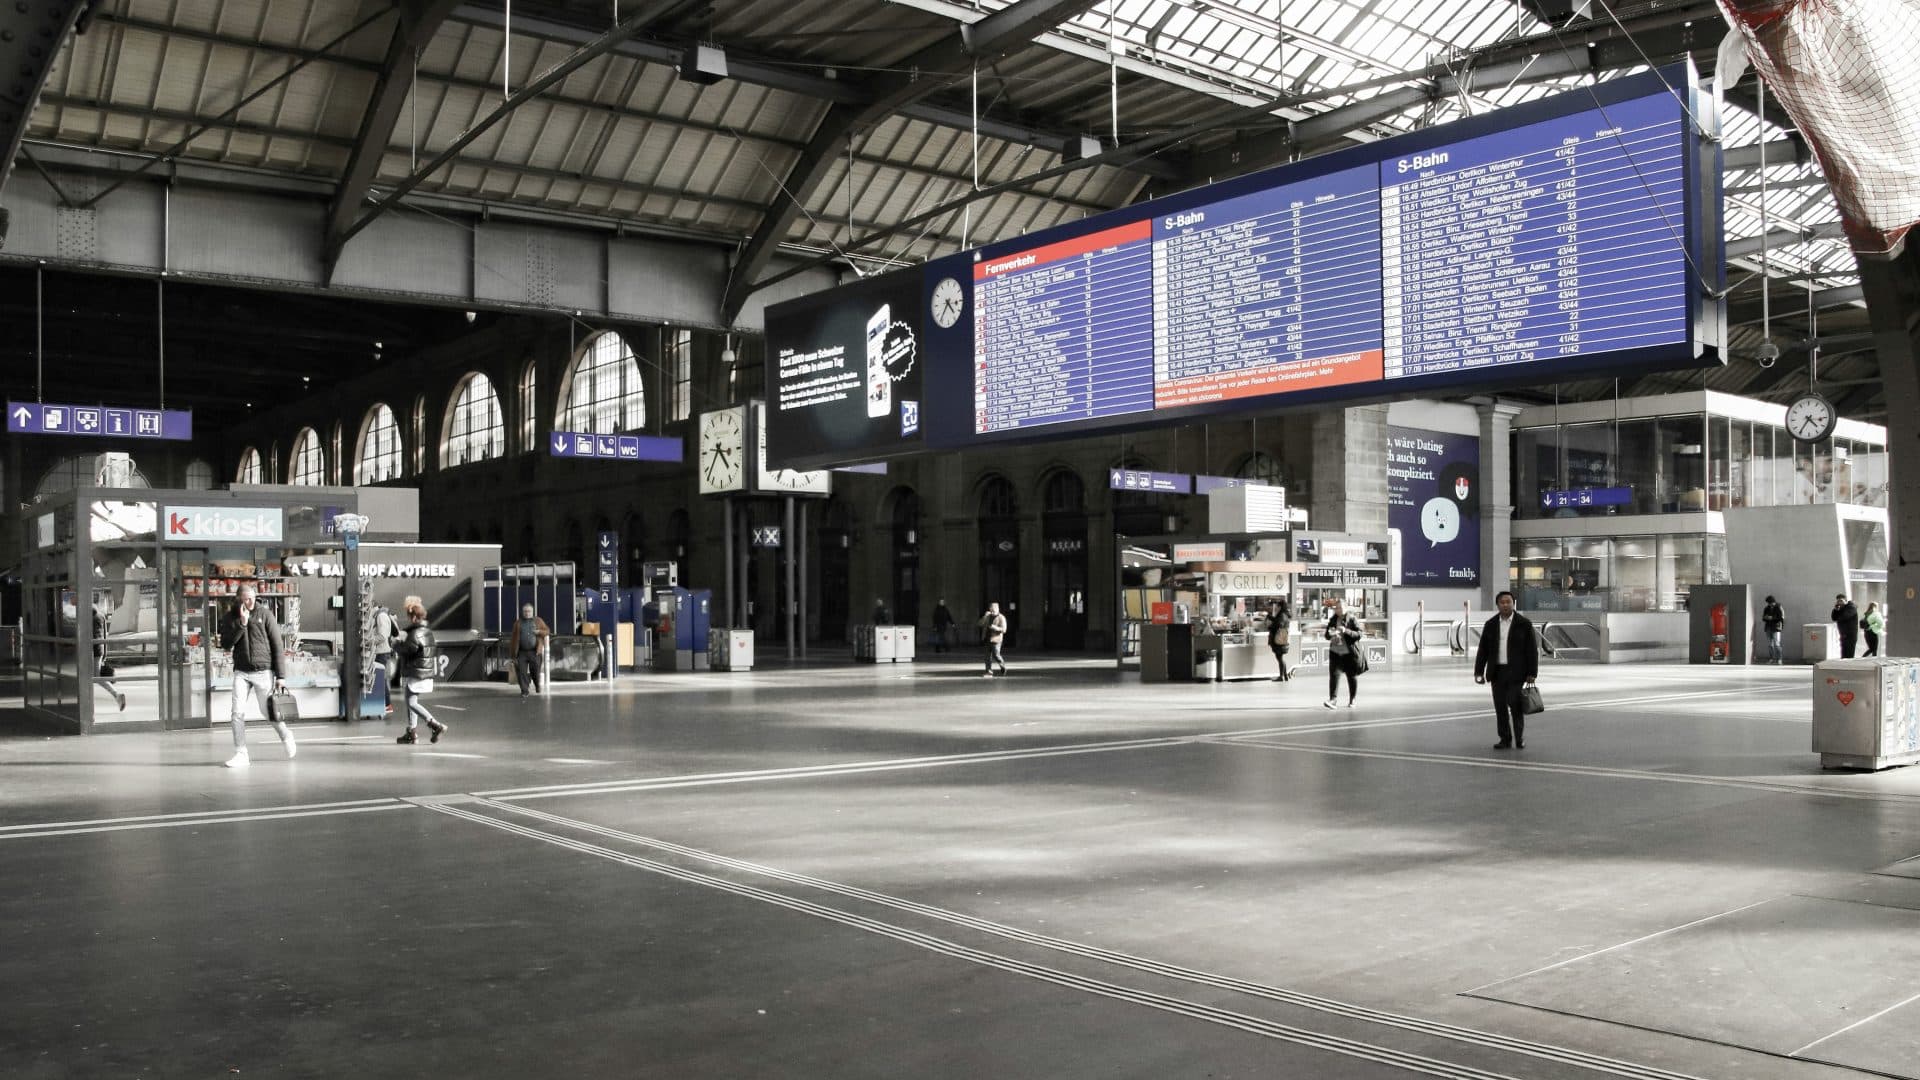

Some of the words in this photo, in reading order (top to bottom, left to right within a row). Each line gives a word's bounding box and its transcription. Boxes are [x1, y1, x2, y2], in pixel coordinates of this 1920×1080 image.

[1398, 152, 1448, 174] S-Bahn
[1489, 158, 1523, 172] Winterthur
[1514, 179, 1527, 188] Zug
[1166, 212, 1204, 230] S-Bahn
[1488, 223, 1522, 236] Winterthur
[986, 254, 1036, 276] Fernverkehr
[1463, 303, 1496, 314] Winterthur
[620, 446, 637, 457] WC
[1394, 437, 1415, 448] wäre
[1417, 439, 1443, 455] Dating
[1396, 452, 1415, 464] auch
[1417, 456, 1426, 465] so
[1558, 496, 1568, 505] 21
[1580, 496, 1590, 504] 34
[194, 512, 274, 537] kiosk
[388, 564, 456, 577] APOTHEKE
[1450, 567, 1476, 580] frankly.
[1234, 576, 1270, 590] GRILL
